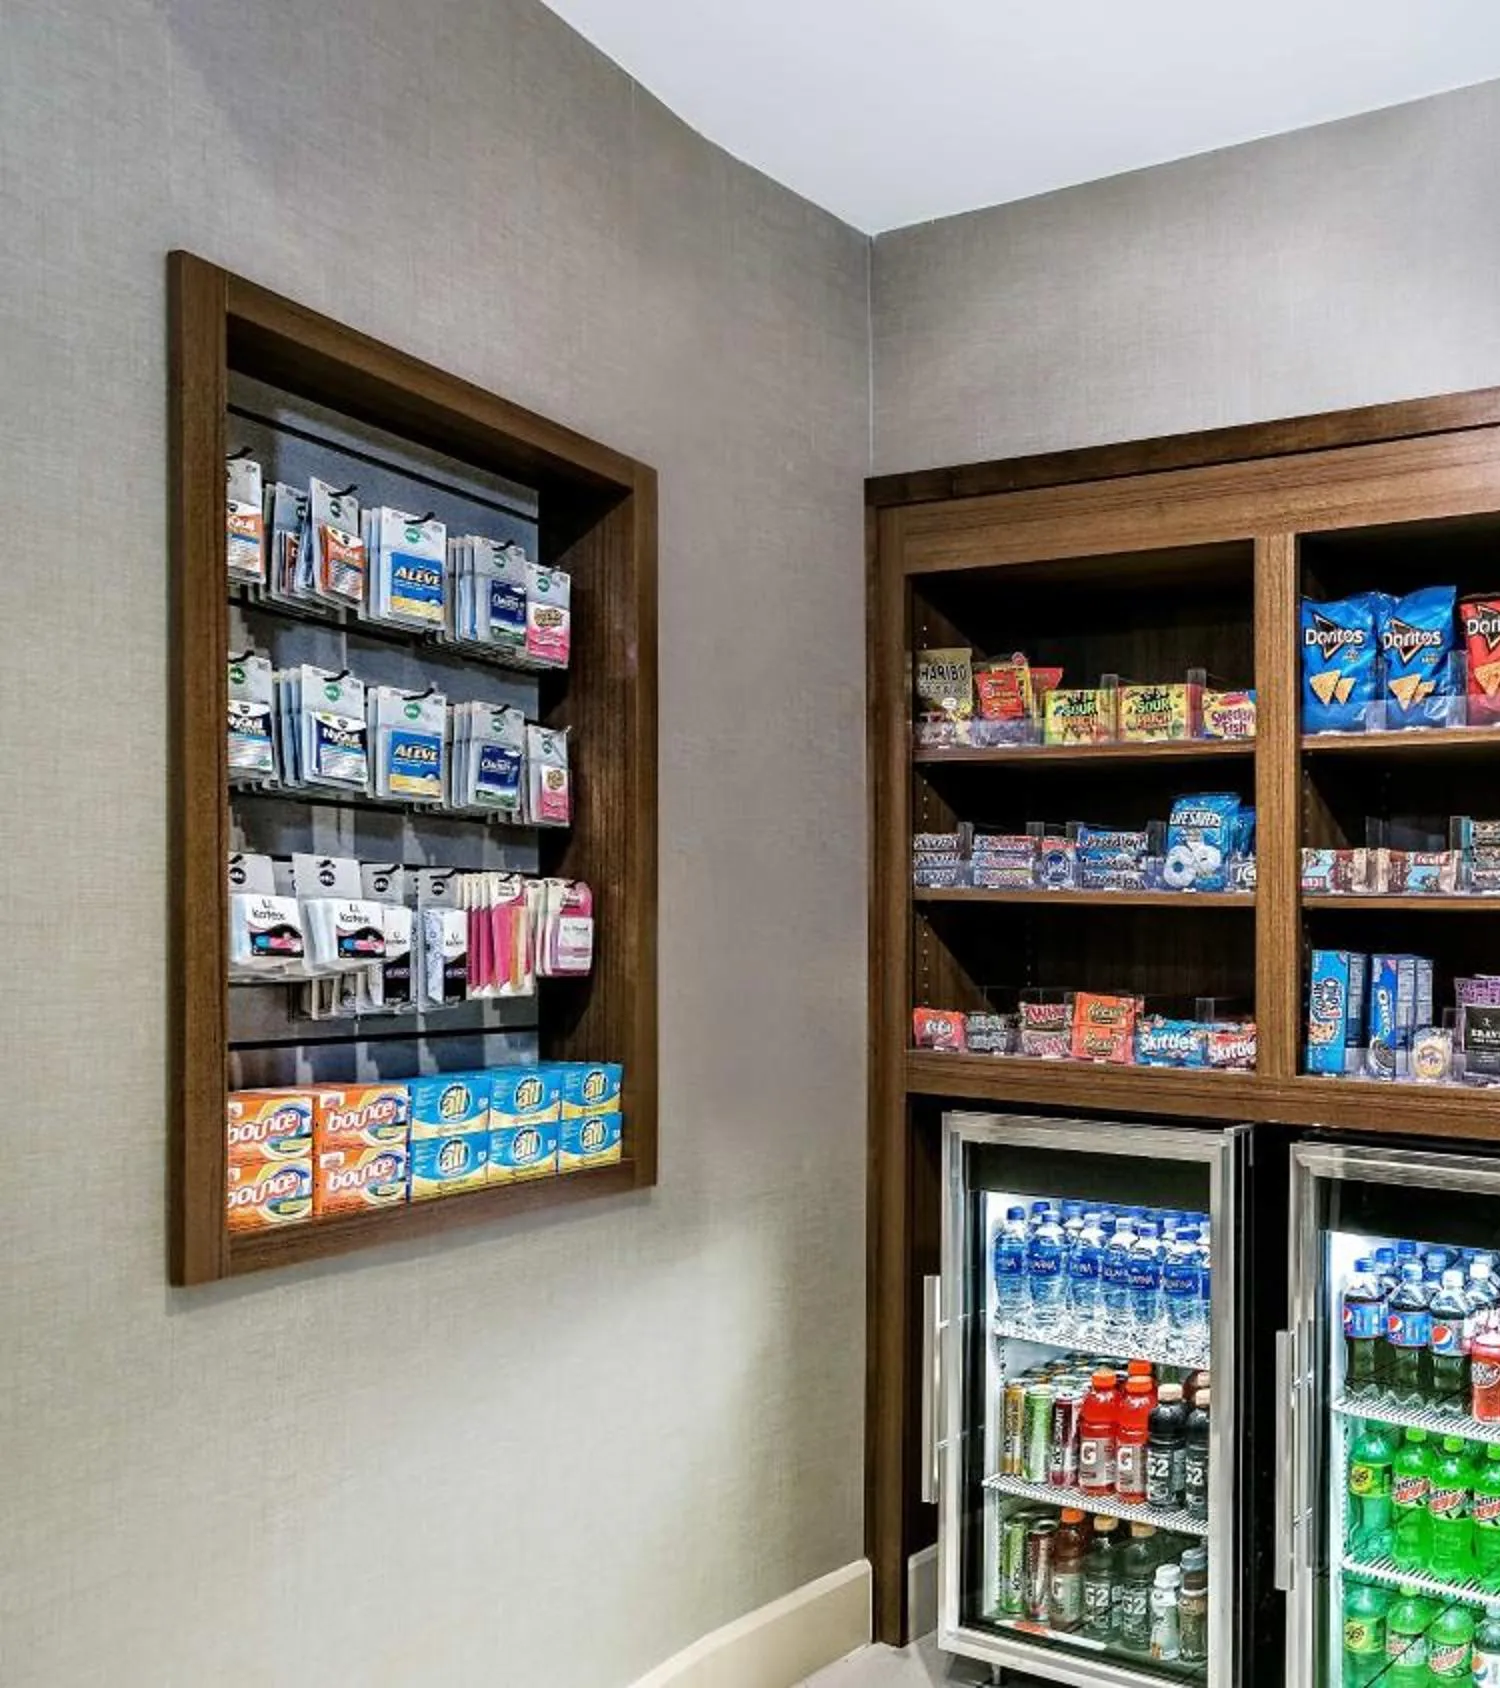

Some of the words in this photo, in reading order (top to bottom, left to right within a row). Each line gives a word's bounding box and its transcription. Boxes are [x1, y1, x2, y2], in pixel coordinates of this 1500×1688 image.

[393, 565, 440, 585] ALEVE
[1305, 628, 1364, 647] Doritos
[1383, 630, 1442, 649] Doritos
[919, 664, 968, 682] HARIBO
[1061, 702, 1097, 715] SOUR
[1137, 698, 1172, 712] SOUR
[1211, 708, 1254, 725] Swedish
[1222, 722, 1248, 736] Fish
[393, 744, 438, 761] ALEVE
[1139, 1031, 1198, 1051] Skittles
[1208, 1038, 1257, 1063] Skittle
[516, 1080, 543, 1109] all
[584, 1073, 606, 1099] all
[442, 1088, 468, 1119] all
[228, 1109, 297, 1146] bounce
[327, 1100, 395, 1133] bounce
[514, 1131, 540, 1161] all
[582, 1121, 604, 1149] all
[441, 1144, 466, 1174] all
[327, 1157, 395, 1192] bounce
[1081, 1441, 1097, 1465] G
[1116, 1447, 1133, 1471] G
